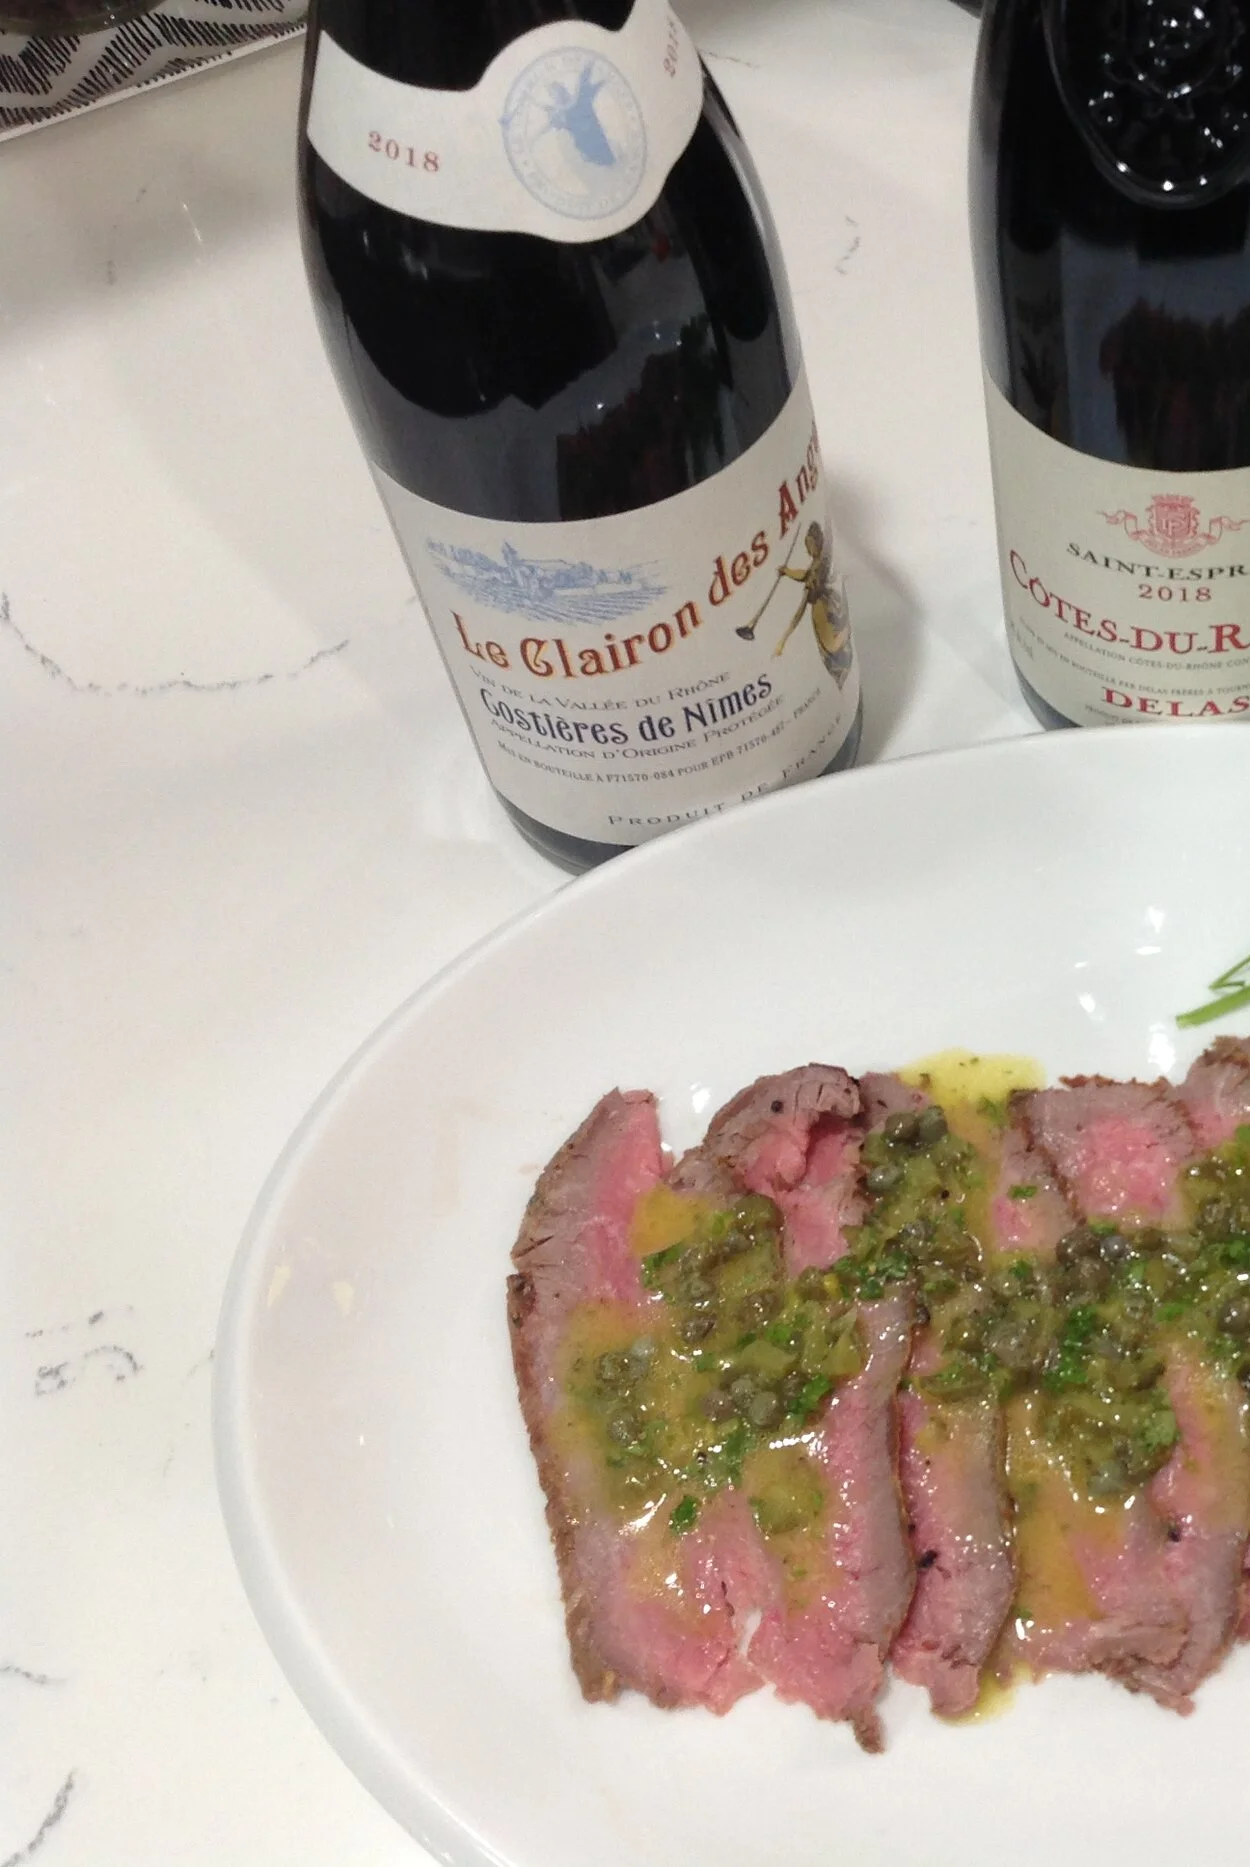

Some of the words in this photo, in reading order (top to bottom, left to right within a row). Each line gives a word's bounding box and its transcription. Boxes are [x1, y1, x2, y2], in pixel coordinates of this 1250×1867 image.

[368, 130, 440, 173] 2018
[449, 608, 512, 670] Le
[519, 601, 704, 678] Clairon
[708, 529, 770, 607] des
[1137, 583, 1213, 603] 2018
[1064, 630, 1126, 662] APPELLATION
[501, 683, 524, 698] DE
[529, 693, 553, 707] LA
[554, 695, 629, 711] VALLÉE
[635, 694, 662, 707] DU
[667, 671, 731, 701] RHÔNE
[1101, 685, 1250, 717] DELAS
[479, 687, 629, 746] Costières
[638, 714, 676, 743] de
[490, 717, 596, 760] APPELLATION
[602, 738, 698, 761] D'ORIGINE
[533, 760, 594, 782] BOUTEILLE
[677, 761, 709, 777] POUR
[711, 749, 734, 766] EPB
[607, 802, 726, 826] PRODUIT
[741, 782, 769, 804] DE
